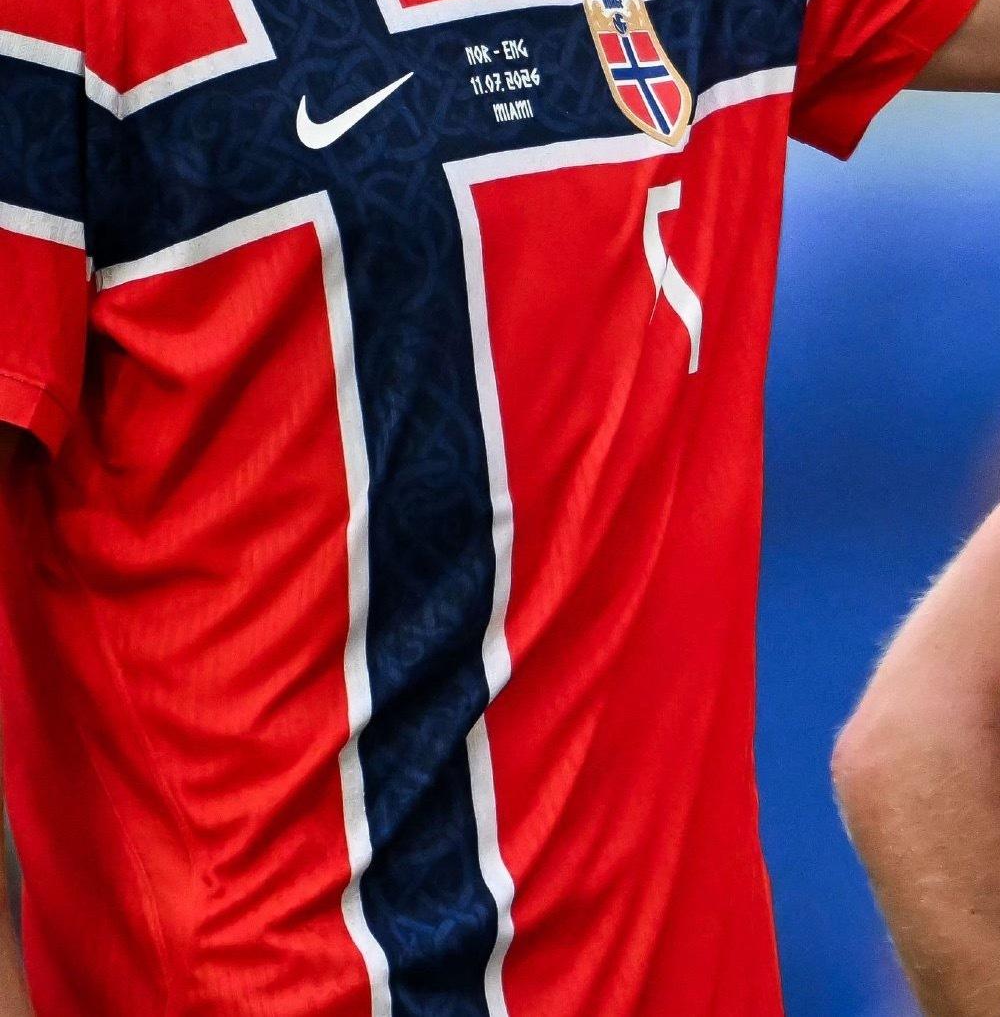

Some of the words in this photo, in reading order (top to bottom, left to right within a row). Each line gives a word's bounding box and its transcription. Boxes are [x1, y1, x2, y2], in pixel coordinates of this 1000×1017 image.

[464, 45, 492, 65] NOR
[501, 38, 529, 60] ENG
[469, 67, 540, 95] 11.07.2026
[492, 99, 534, 122] MIAMI
